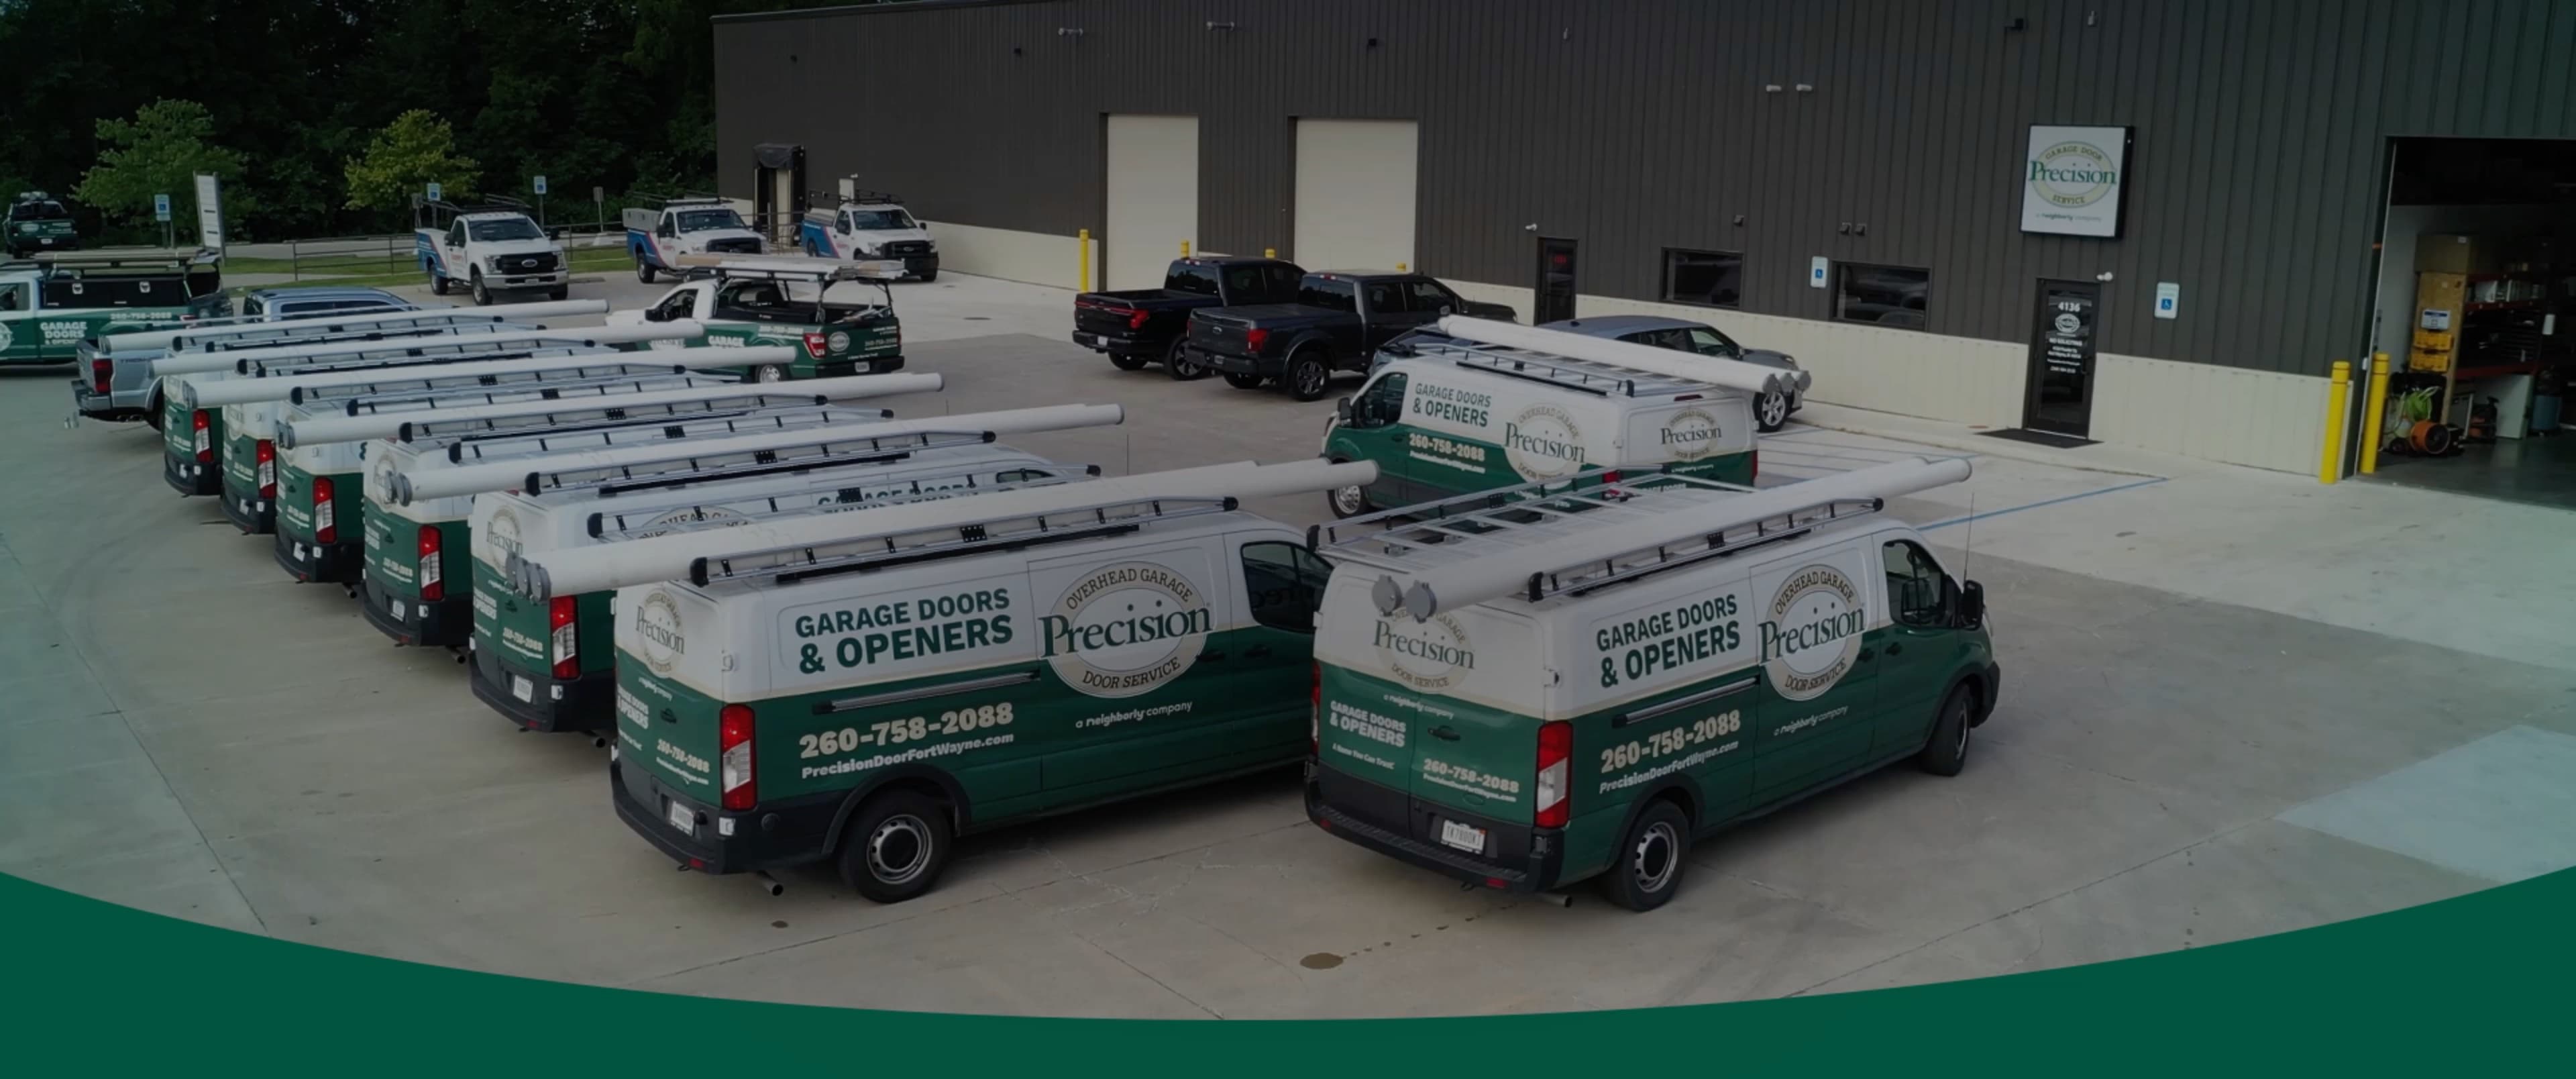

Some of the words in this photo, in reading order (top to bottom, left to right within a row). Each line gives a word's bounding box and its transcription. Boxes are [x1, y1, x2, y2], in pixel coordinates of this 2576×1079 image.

[2045, 146, 2078, 160] GARAGE
[2081, 147, 2103, 160] DOOR
[2028, 160, 2117, 185] Precision
[2057, 301, 2081, 313] 4136
[40, 321, 87, 331] GARAGE
[44, 330, 85, 339] DOORS
[708, 336, 745, 347] GARAGE
[1413, 398, 1421, 413] &
[1426, 401, 1489, 427] OPENERS
[1415, 383, 1454, 401] GARAGE
[1456, 391, 1491, 408] DOORS
[1409, 433, 1485, 462] 260-758-2088
[1505, 422, 1585, 463] Precision
[1660, 424, 1722, 445] Precision
[1067, 568, 1137, 610] OVERHEAD
[1140, 568, 1193, 603] GARAGE
[1775, 571, 1819, 615] OVERHEAD
[1820, 571, 1854, 603] GARAGE
[635, 605, 684, 656] Precision
[795, 603, 911, 638] GARAGE
[918, 588, 1010, 619] DOORS
[1038, 599, 1213, 658] Precision
[1597, 612, 1673, 652] GARAGE
[1678, 594, 1737, 628] DOORS
[799, 644, 825, 674] &
[837, 614, 1013, 668] OPENERS
[1372, 619, 1475, 670] Precision
[1758, 603, 1865, 664] Precision
[1601, 657, 1618, 688] &
[1625, 621, 1741, 680] OPENERS
[1082, 670, 1120, 689] DOOR
[1123, 658, 1181, 688] SERVICE
[1391, 663, 1413, 683] DOOR
[1414, 676, 1450, 688] SERVICE
[1784, 674, 1808, 692] DOOR
[1809, 660, 1847, 691] SERVICE
[799, 702, 1014, 759] 260-758-2088
[1075, 719, 1083, 729] a
[1085, 707, 1144, 729] neighborly
[1146, 701, 1193, 720] company
[1330, 700, 1368, 721] GARAGE
[1370, 712, 1407, 733] DOORS
[1330, 712, 1338, 727] &
[1340, 715, 1405, 748] OPENERS
[1780, 715, 1819, 735] neighborly
[1819, 705, 1848, 721] company
[801, 732, 1014, 780] PrecisionDoorFortWayne.com
[1601, 709, 1741, 774] 260-758-2088
[1423, 758, 1519, 793] 260-758-2088
[1599, 740, 1739, 794] PrecisionDoorFortWayne.com
